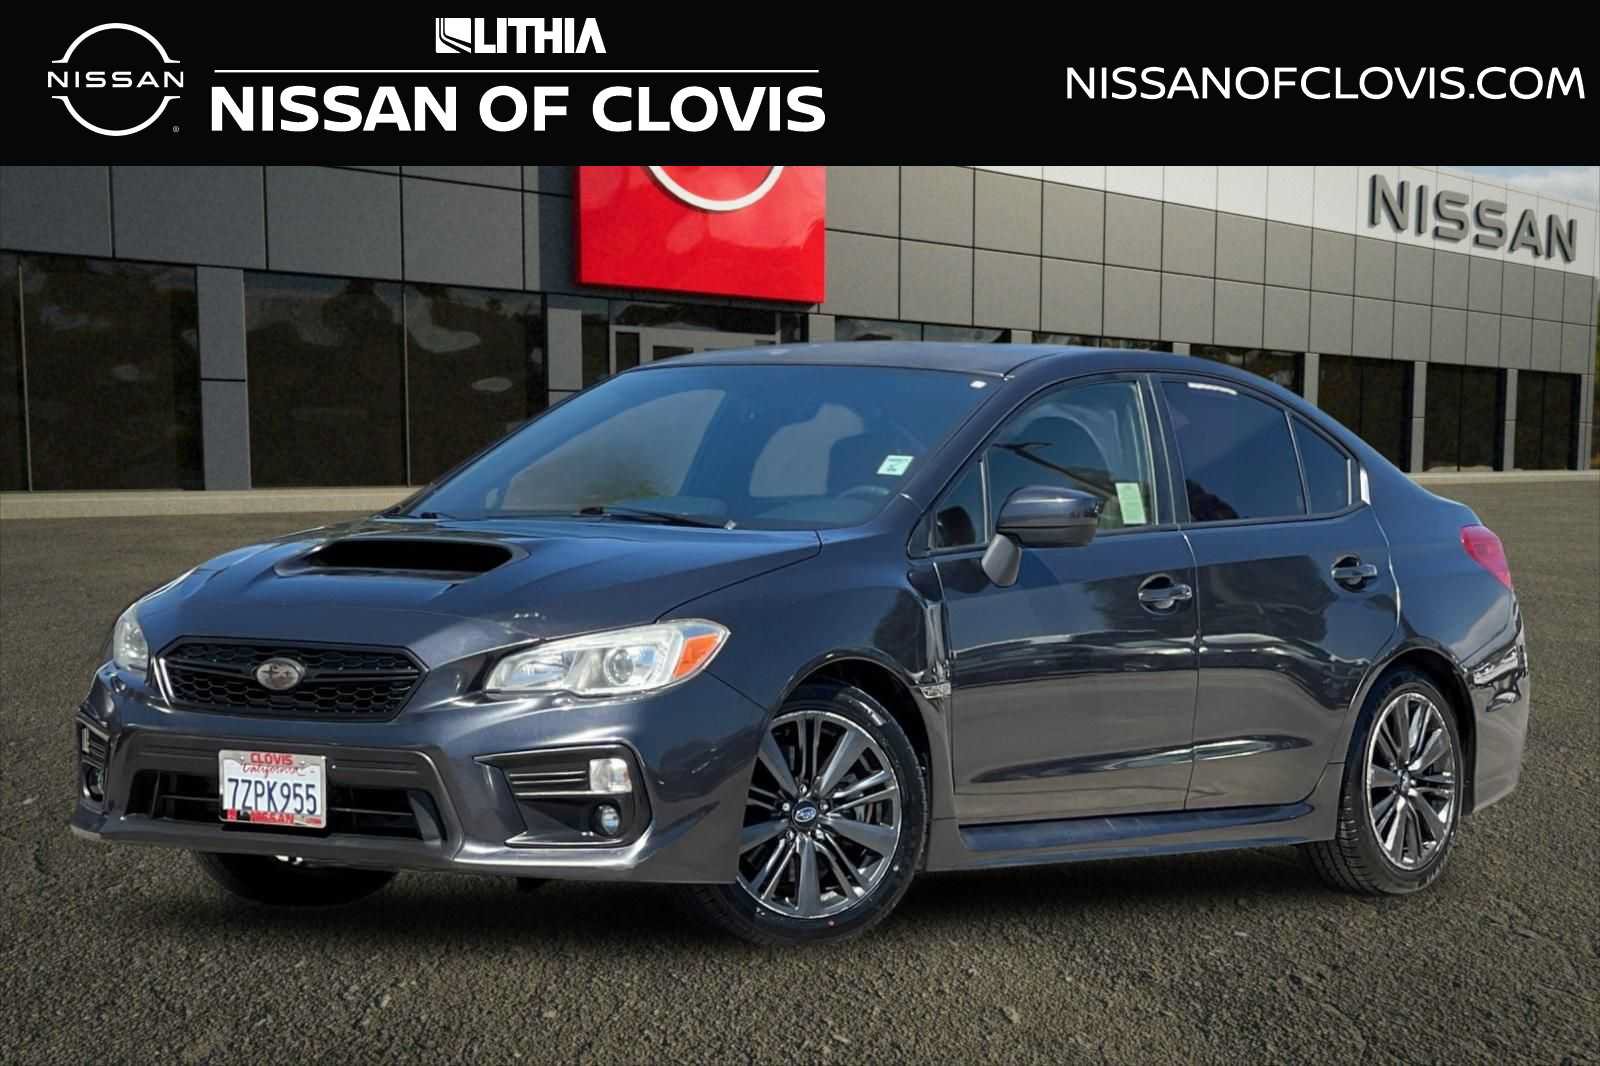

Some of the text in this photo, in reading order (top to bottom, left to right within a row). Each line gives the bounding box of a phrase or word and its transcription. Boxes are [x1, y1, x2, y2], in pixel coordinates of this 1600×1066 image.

[1368, 173, 1577, 263] NISSAN
[250, 752, 293, 766] CLOVIS
[227, 778, 317, 815] 7ZPK955
